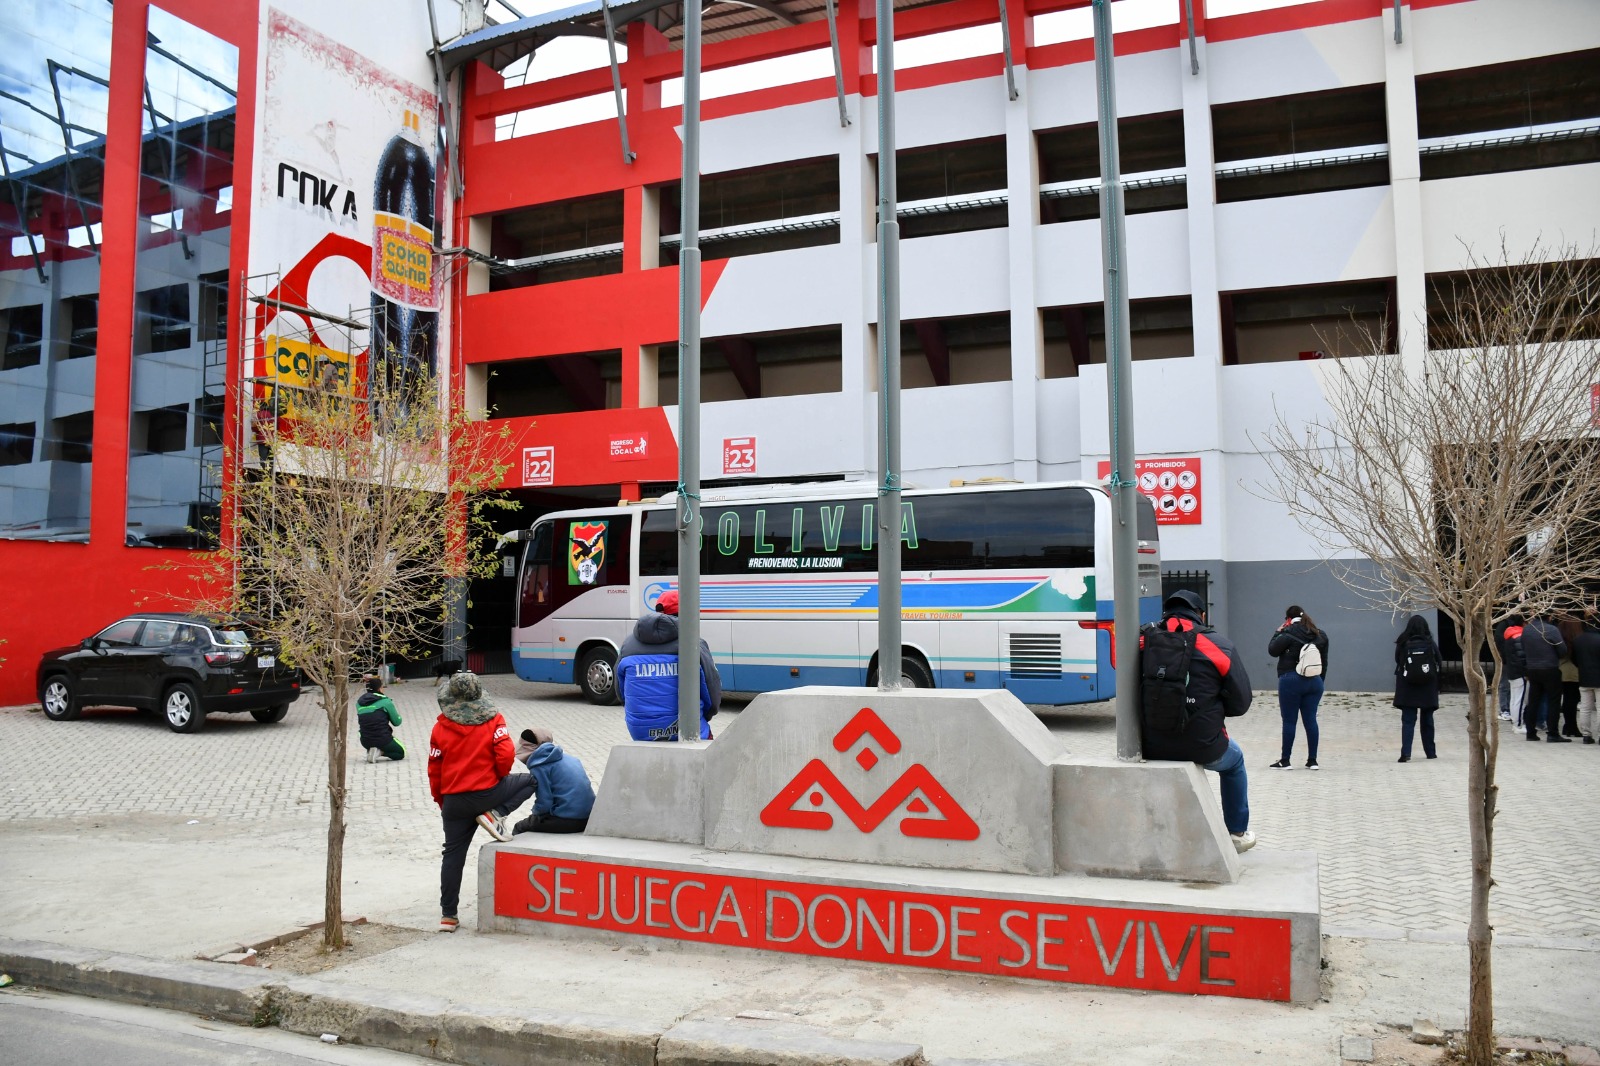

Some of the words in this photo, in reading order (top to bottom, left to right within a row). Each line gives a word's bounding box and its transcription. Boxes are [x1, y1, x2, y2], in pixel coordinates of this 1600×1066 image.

[386, 241, 427, 268] COKA
[386, 260, 427, 285] QUINA
[274, 347, 349, 387] COA
[529, 460, 551, 478] 22
[729, 448, 755, 468] 23
[699, 502, 919, 556] OLIVIA
[748, 557, 799, 569] #RENOVEMOS,
[801, 557, 811, 568] LA
[812, 557, 843, 568] ILUSION
[929, 612, 963, 620] TOURISM
[527, 864, 577, 917] SE
[587, 871, 748, 938] JUEGA
[765, 889, 981, 963] DONDE
[998, 909, 1069, 971] SE
[1086, 916, 1236, 986] VIVE
